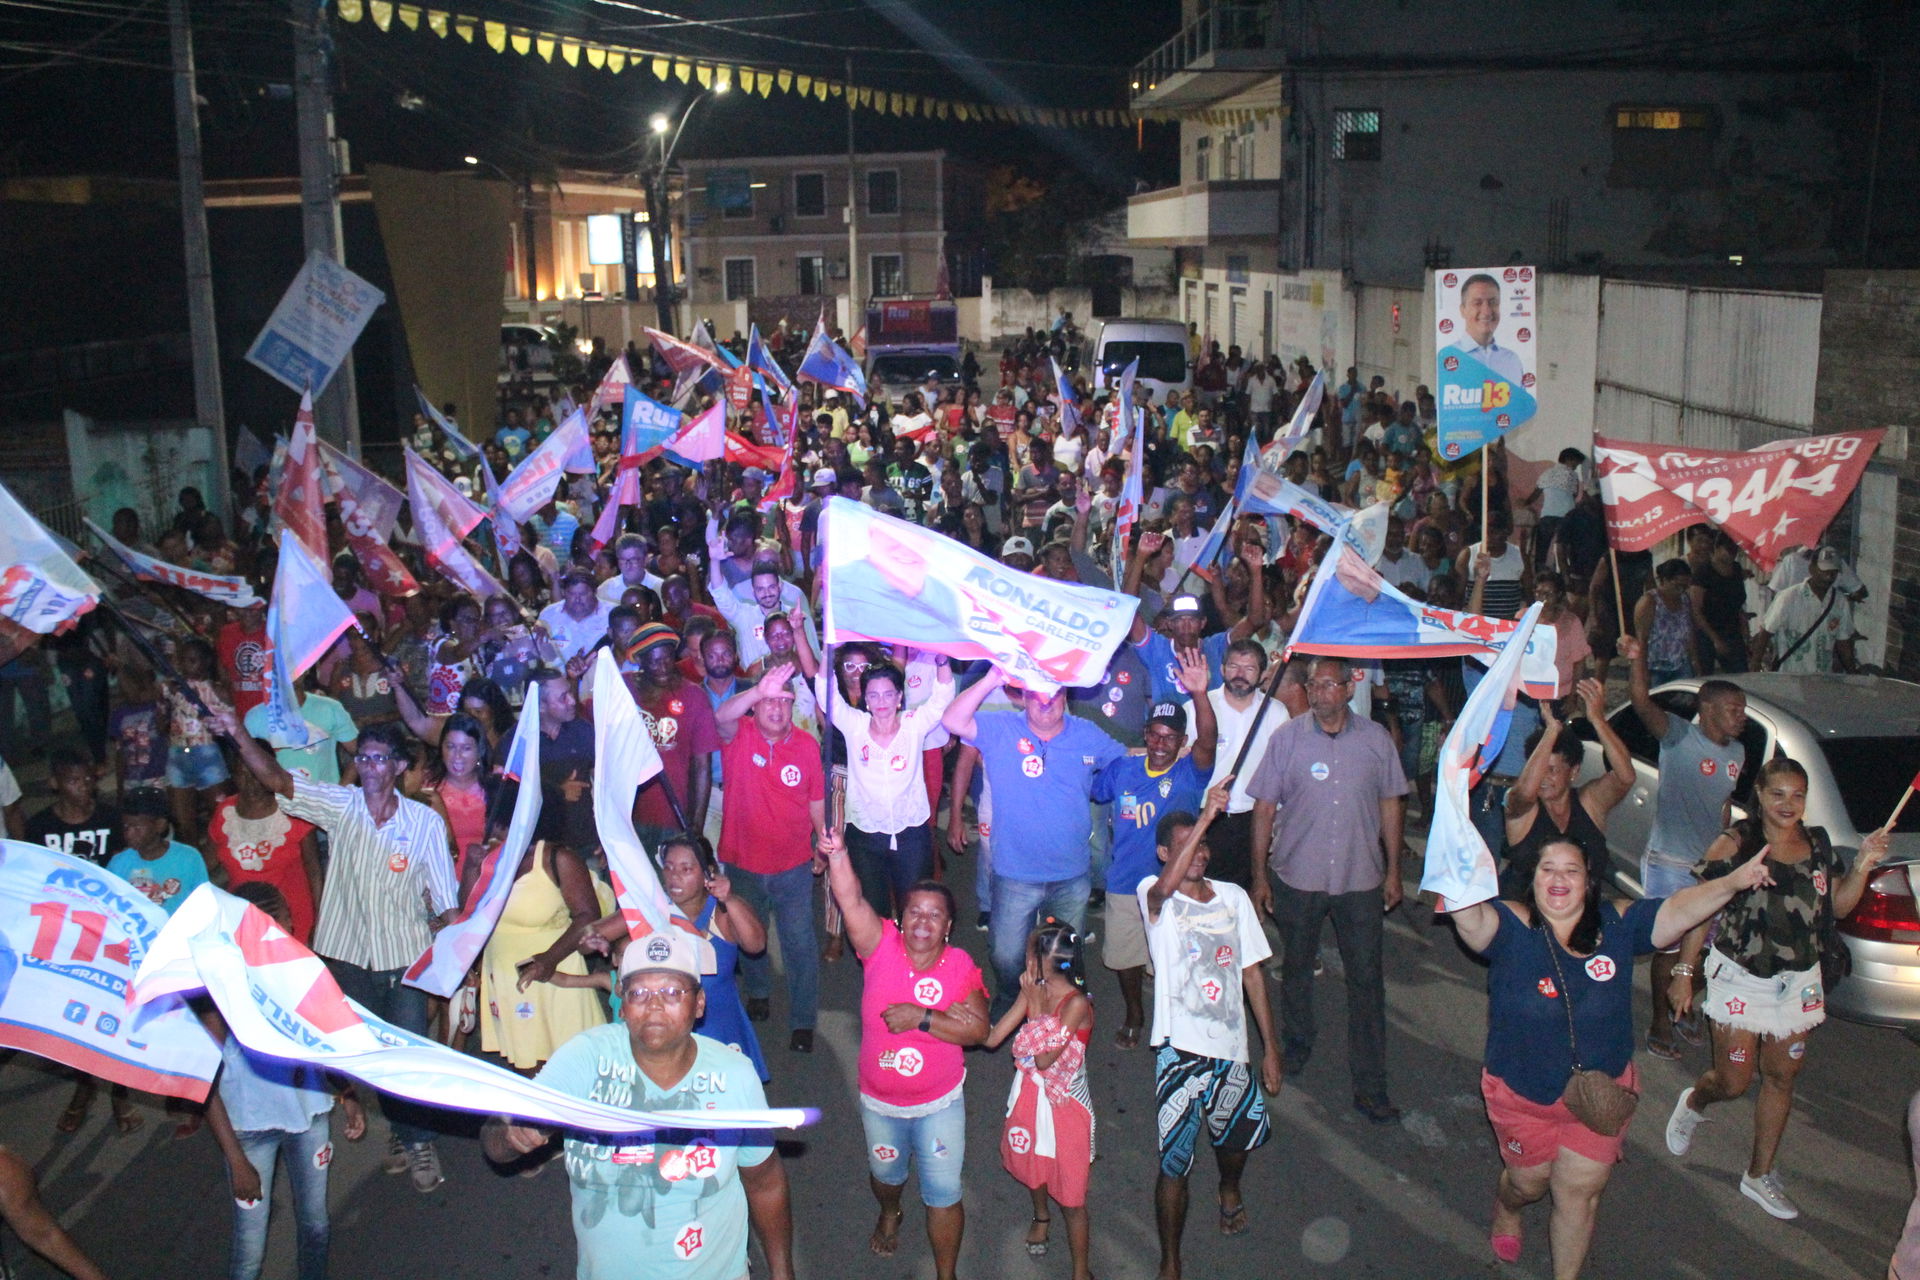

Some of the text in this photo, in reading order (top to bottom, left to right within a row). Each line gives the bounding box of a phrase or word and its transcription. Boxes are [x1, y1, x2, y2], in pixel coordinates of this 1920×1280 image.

[1443, 381, 1510, 412] Rui 13
[964, 565, 1110, 638] RONALDO
[1025, 615, 1103, 651] CARLETTO
[1136, 801, 1155, 829] 10
[1593, 962, 1607, 973] 13
[921, 986, 935, 998] 13
[1202, 986, 1214, 997] 13
[1013, 1134, 1025, 1146] 13
[694, 1148, 711, 1167] 13
[683, 1231, 700, 1248] 13
